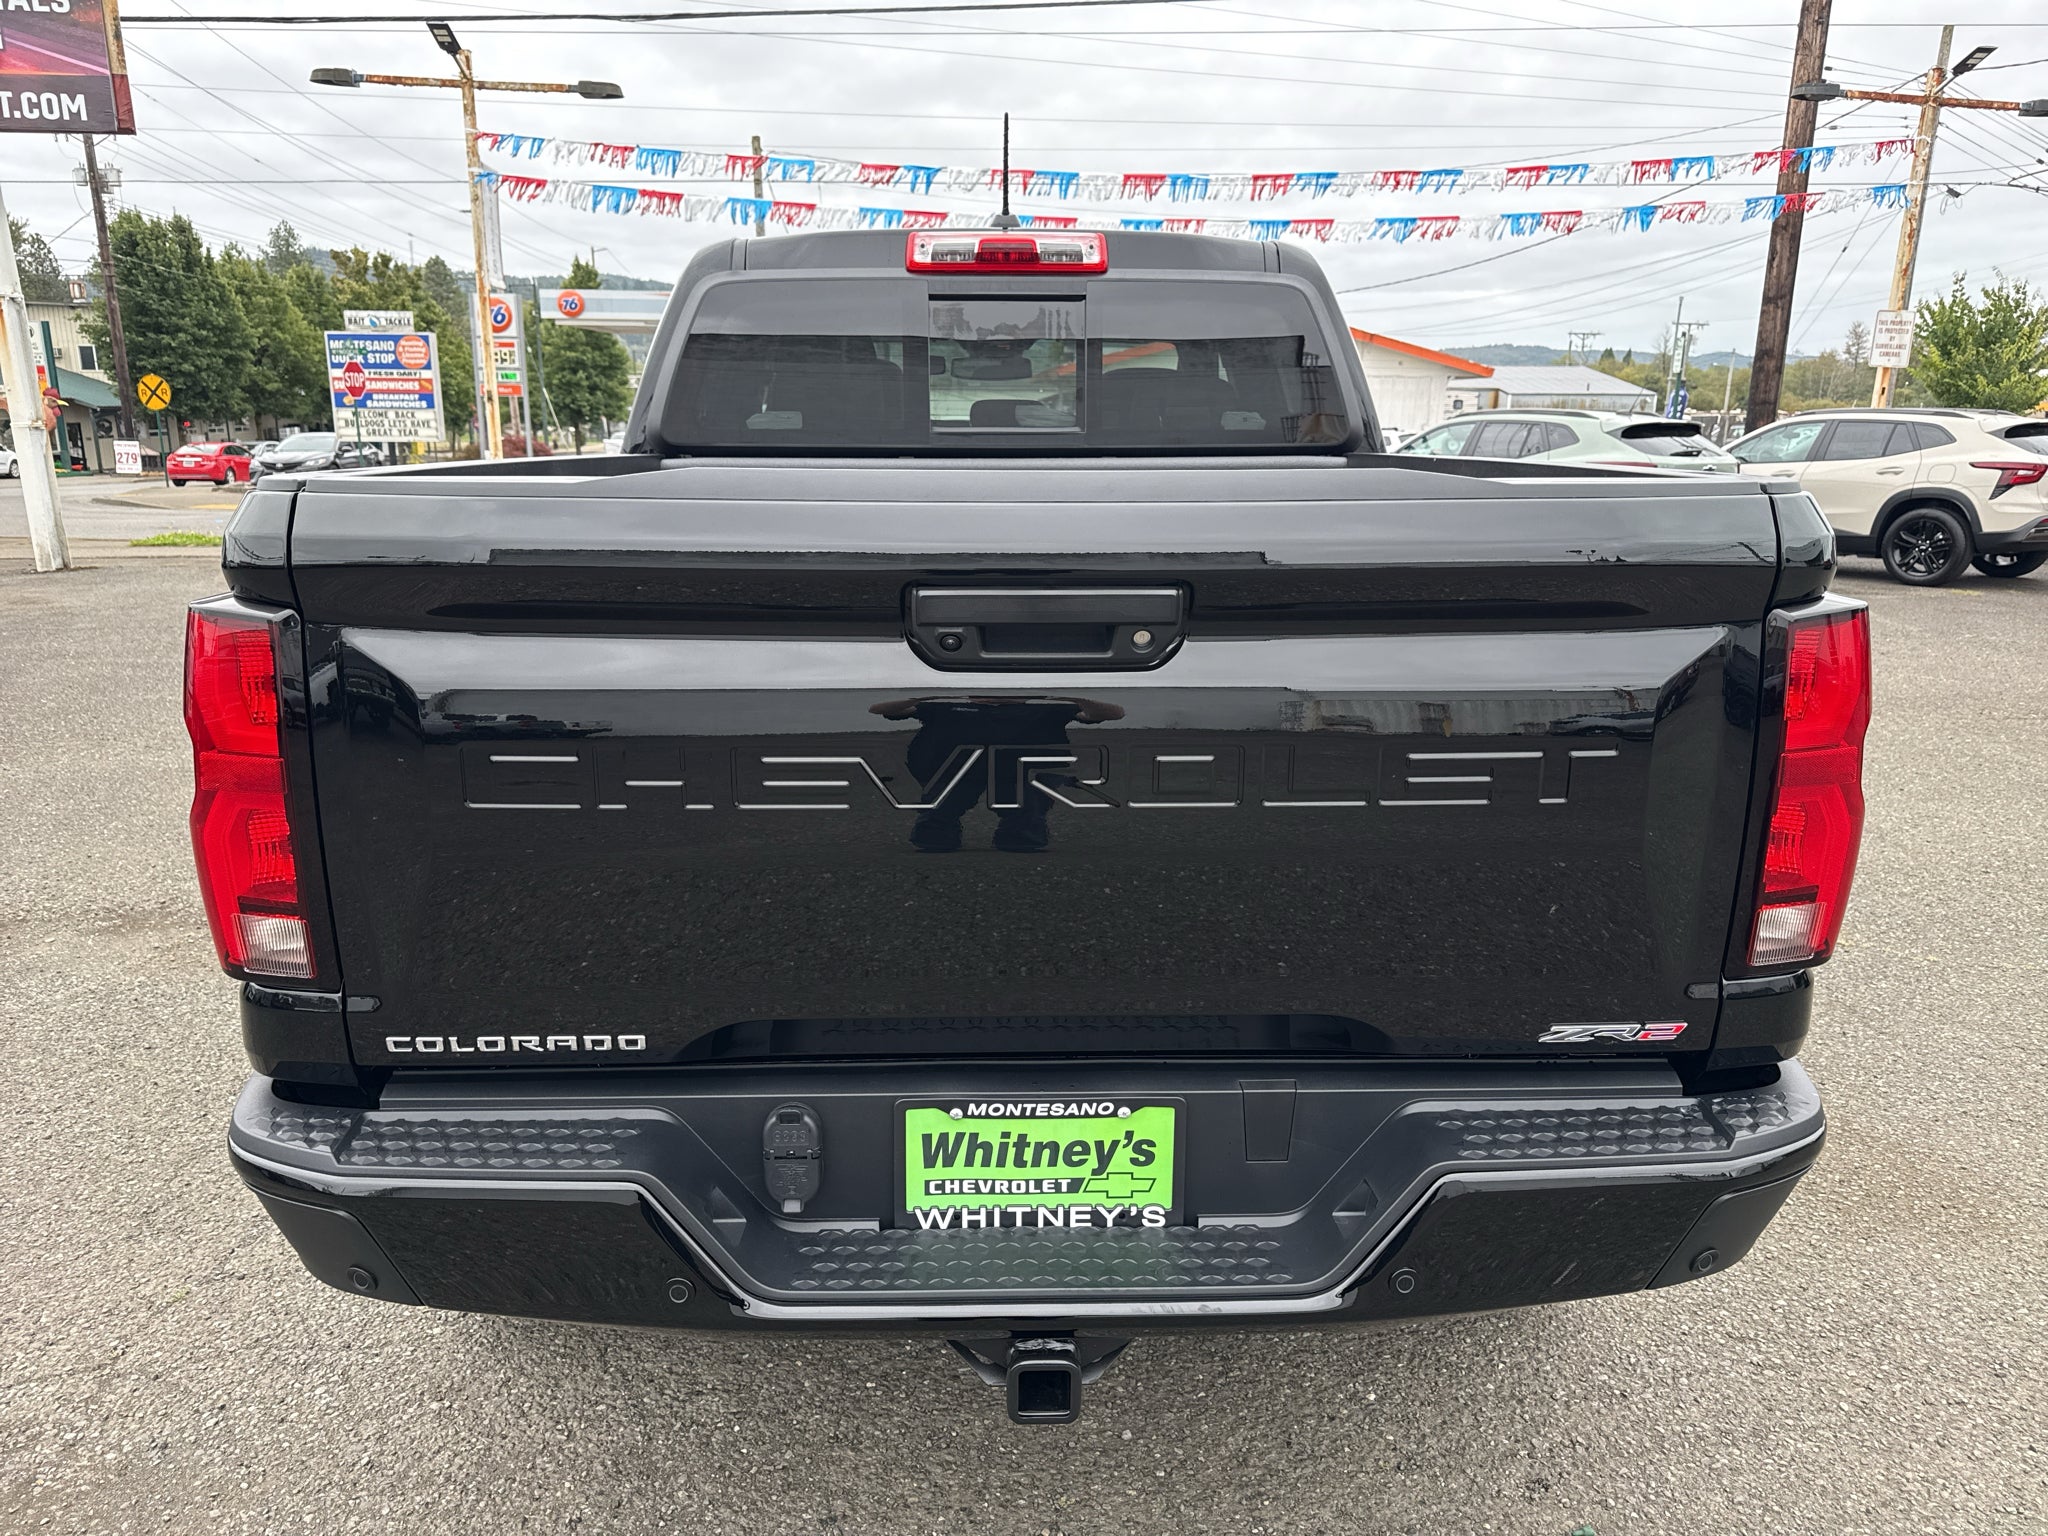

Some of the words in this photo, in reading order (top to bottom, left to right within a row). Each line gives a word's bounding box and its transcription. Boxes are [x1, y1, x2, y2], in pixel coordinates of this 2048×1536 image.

[563, 298, 579, 311] 76
[347, 317, 365, 325] BAIT
[385, 317, 411, 326] TACKLE
[330, 340, 395, 352] MTESANO
[367, 353, 396, 364] STOP
[344, 372, 365, 388] STOP
[366, 380, 420, 391] SANDWICHES
[141, 389, 148, 398] R
[161, 388, 169, 397] R
[366, 401, 428, 409] SANDWICHES
[395, 411, 416, 419] BACK
[344, 419, 385, 429] BULDOGS
[388, 420, 407, 429] LETS
[411, 420, 431, 429] HAVE
[366, 429, 393, 437] GREAT
[397, 429, 419, 437] YEAR
[459, 744, 1620, 810] CHEVROLET
[1537, 1021, 1689, 1043] ZR2
[385, 1035, 647, 1053] COLORADO
[966, 1102, 1115, 1117] MONTESANO
[920, 1130, 1157, 1177] Whitney's
[928, 1178, 1072, 1195] CHEVROLET
[914, 1204, 1167, 1231] WHITNEY'S
